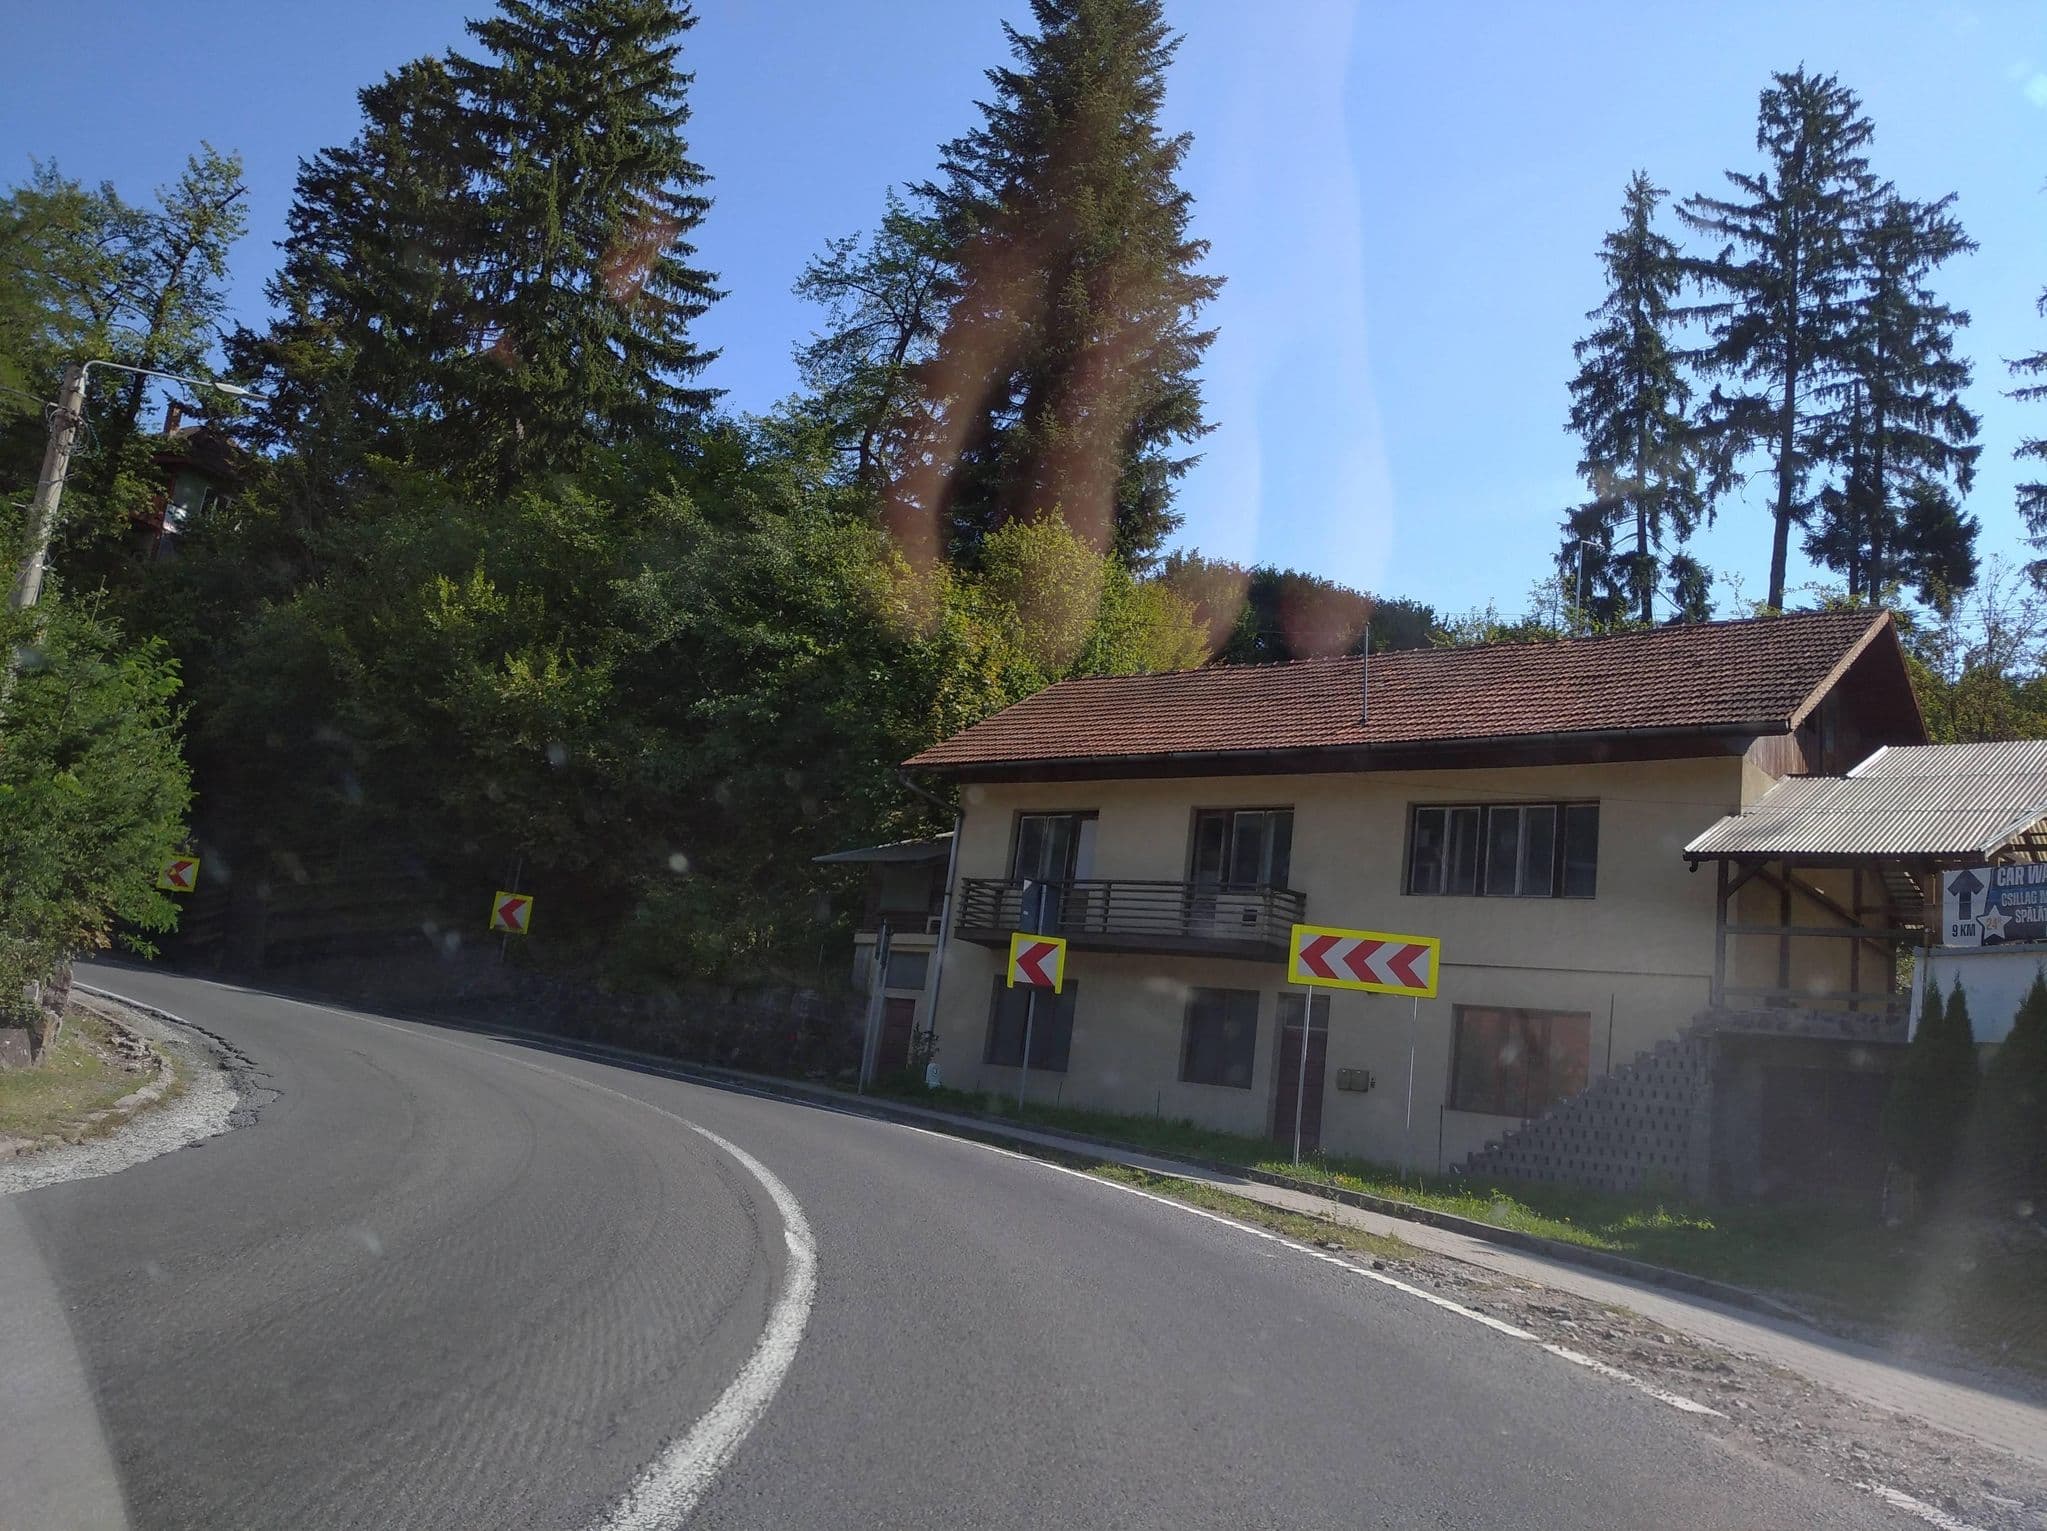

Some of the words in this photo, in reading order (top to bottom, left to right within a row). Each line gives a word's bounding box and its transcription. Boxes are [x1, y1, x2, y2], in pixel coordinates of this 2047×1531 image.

[1997, 866, 2024, 886] CAR
[2001, 890, 2037, 907] CSILLAG
[1952, 924, 1958, 937] 9
[1960, 923, 1976, 937] KM
